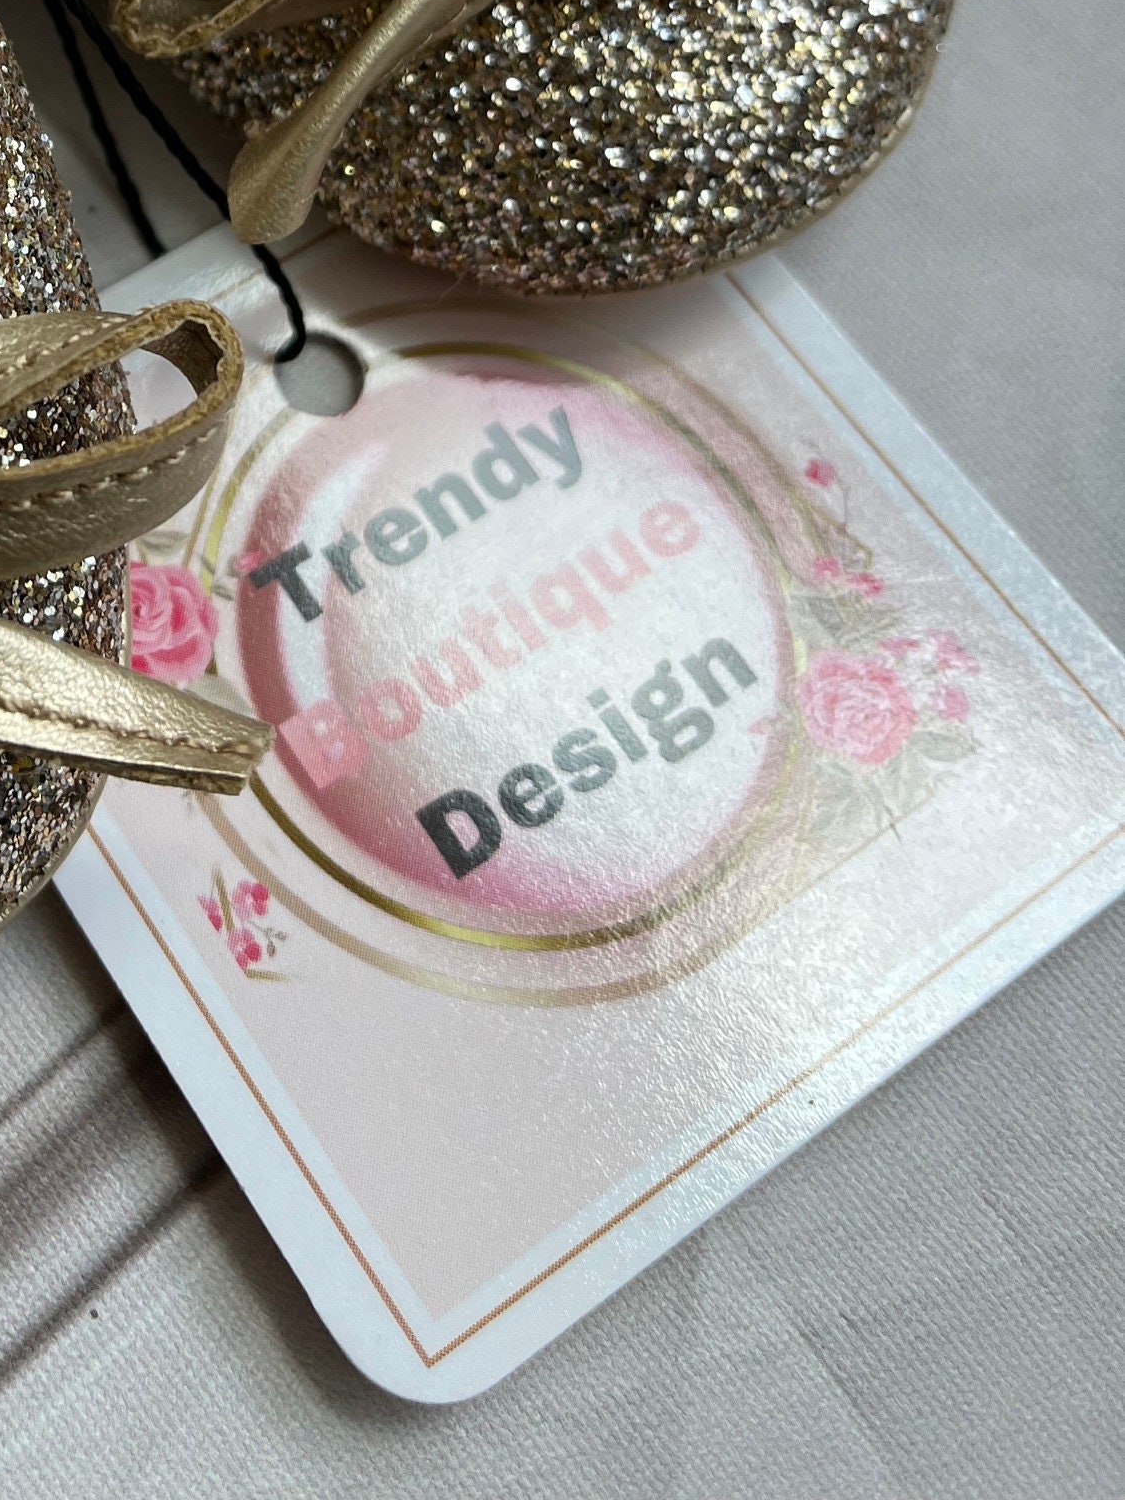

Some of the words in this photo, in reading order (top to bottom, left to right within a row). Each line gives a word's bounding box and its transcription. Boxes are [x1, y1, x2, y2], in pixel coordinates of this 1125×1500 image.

[248, 405, 584, 623] Trendy
[279, 503, 701, 789] Boutique
[415, 636, 757, 880] Design
